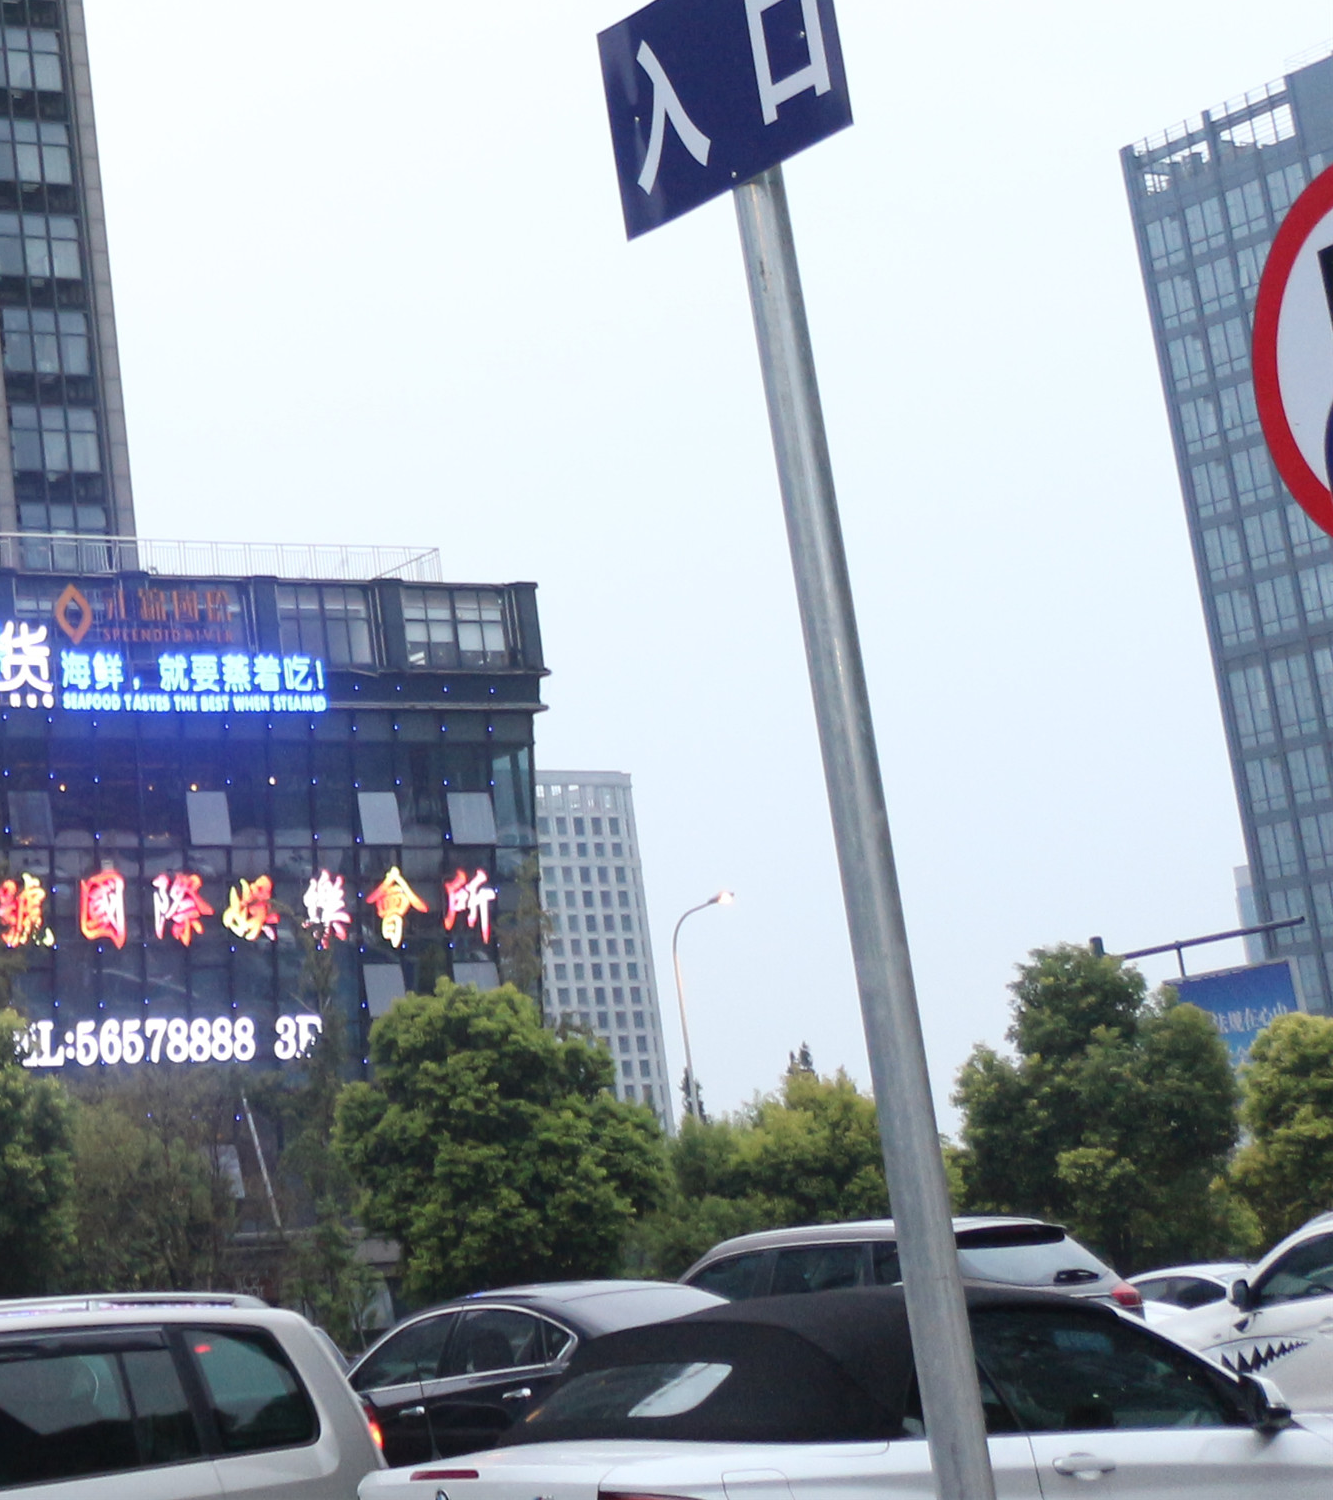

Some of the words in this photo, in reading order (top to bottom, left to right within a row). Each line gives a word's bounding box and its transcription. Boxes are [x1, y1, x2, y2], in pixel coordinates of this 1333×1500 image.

[62, 691, 121, 711] SEAFOOD
[173, 694, 198, 712] THE
[200, 694, 229, 712] BEST
[232, 695, 270, 713] WHEN
